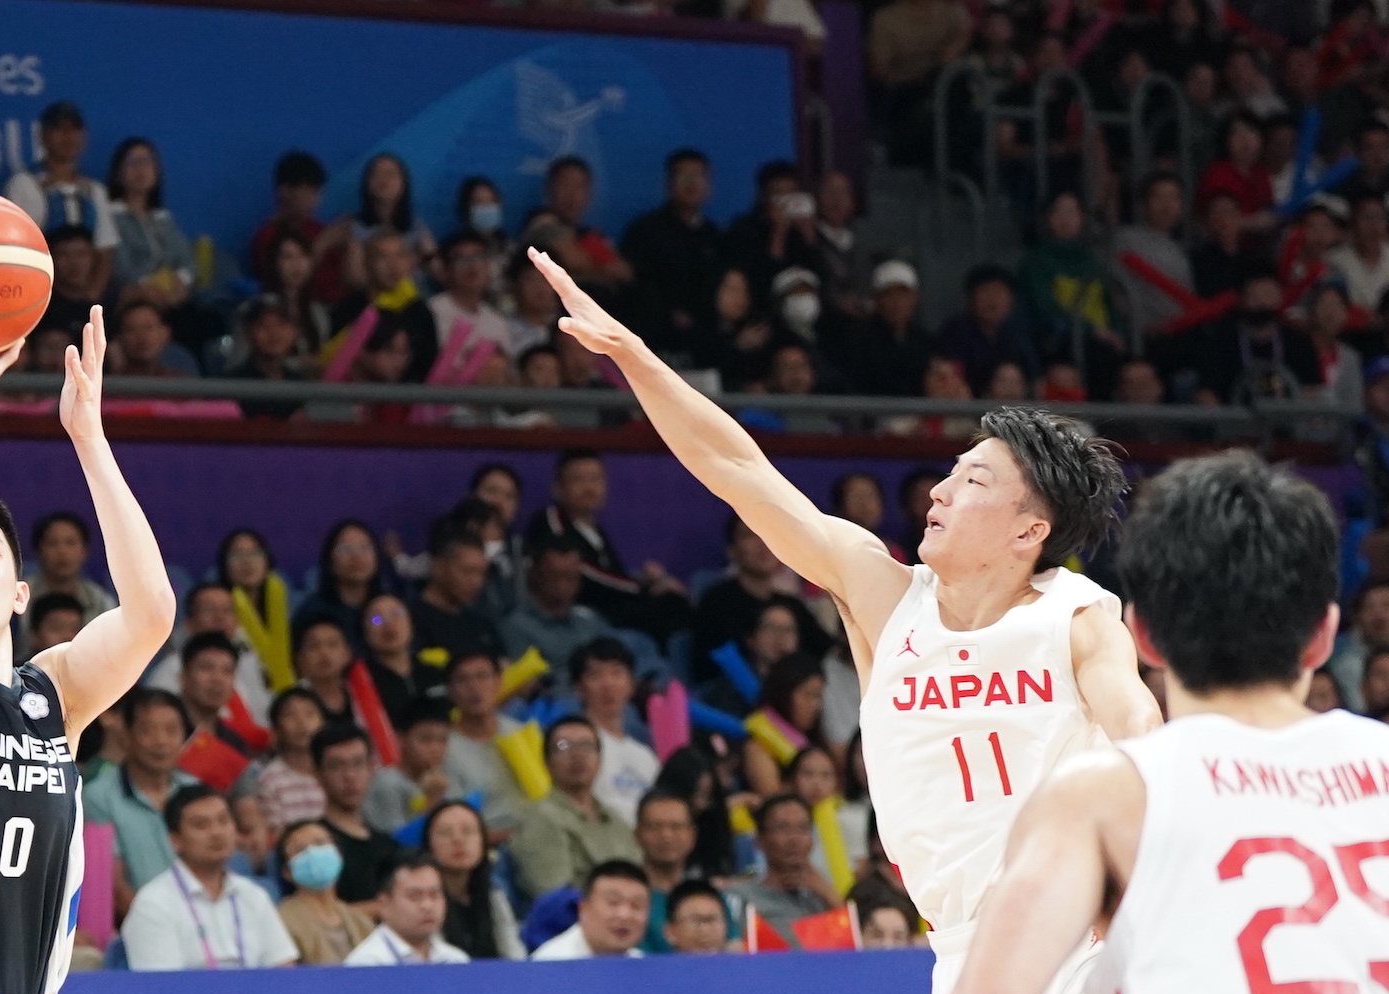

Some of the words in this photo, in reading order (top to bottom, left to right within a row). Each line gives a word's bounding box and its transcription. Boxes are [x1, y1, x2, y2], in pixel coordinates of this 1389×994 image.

[893, 669, 1053, 711] JAPAN
[951, 732, 1012, 802] 11
[0, 816, 35, 878] 0
